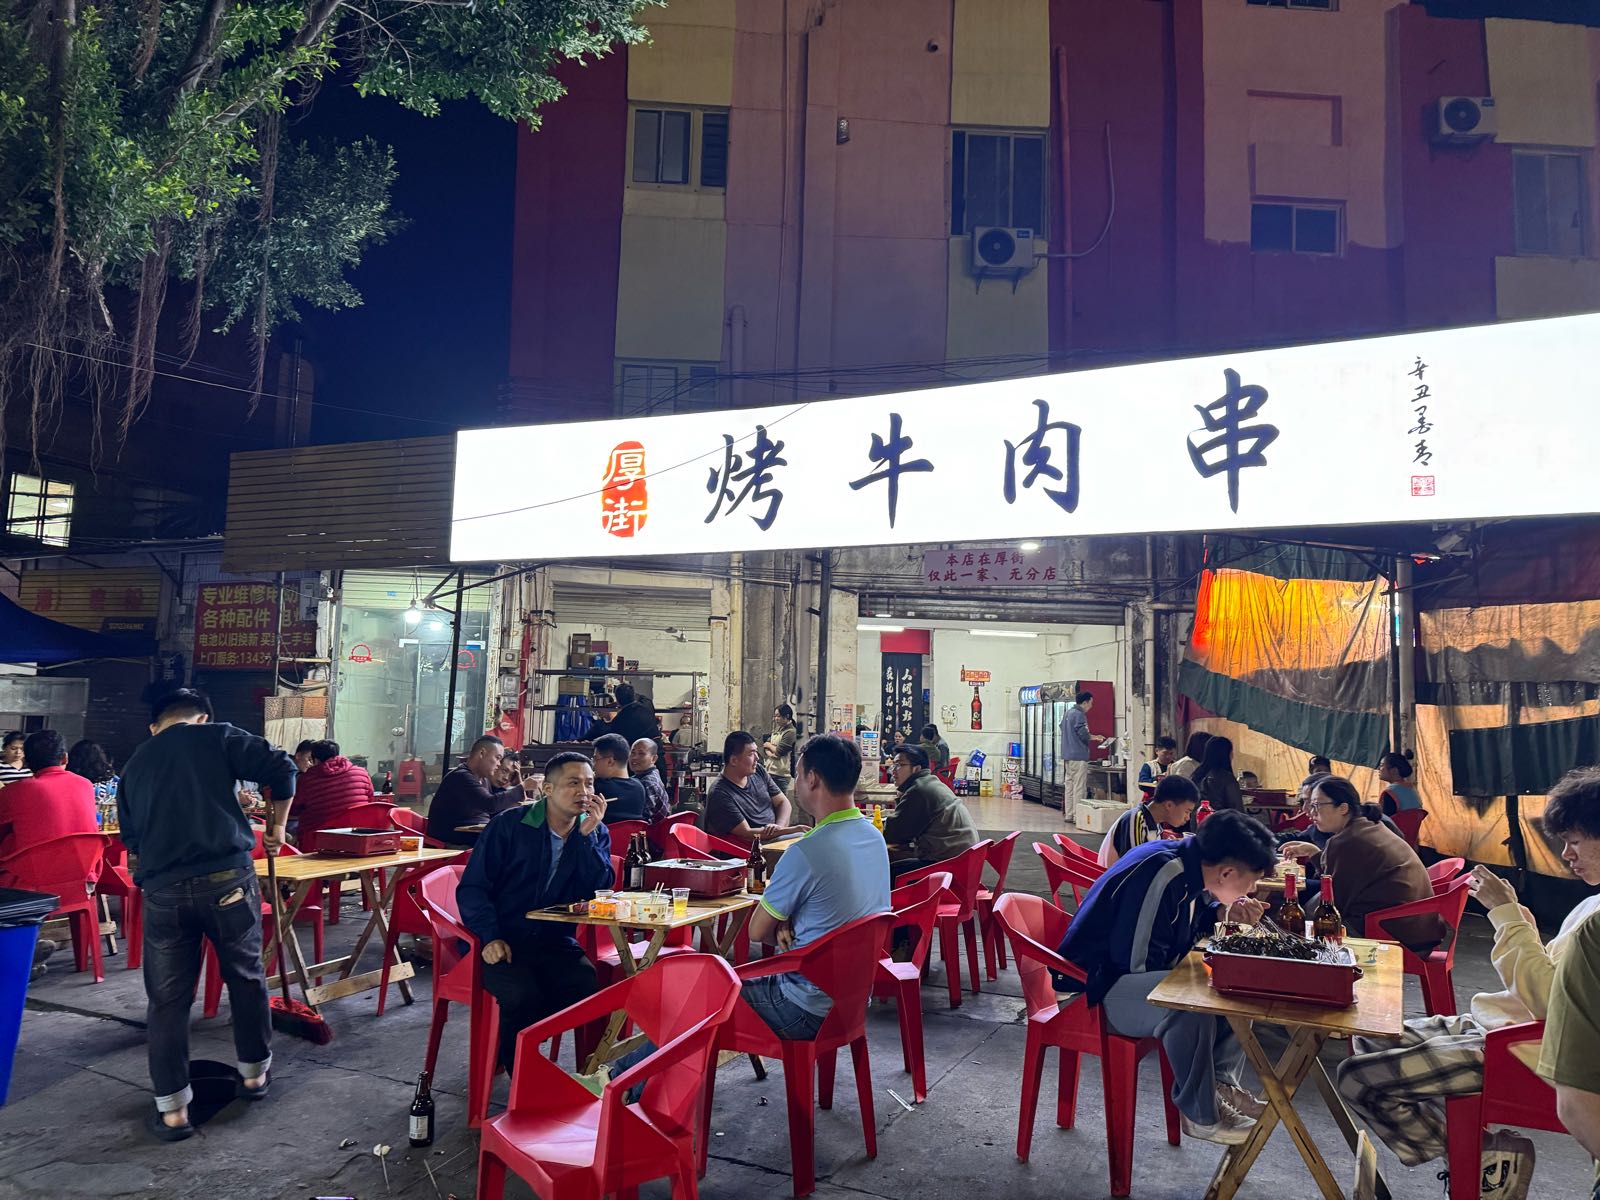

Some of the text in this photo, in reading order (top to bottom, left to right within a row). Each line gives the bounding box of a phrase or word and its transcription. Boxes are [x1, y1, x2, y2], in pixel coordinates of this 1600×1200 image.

[705, 368, 1280, 532] 烤牛肉串
[600, 444, 648, 538] 厚街
[945, 551, 1025, 566] 本店在厚街
[203, 607, 271, 629] 各种配件
[199, 632, 258, 647] 电池以旧换新
